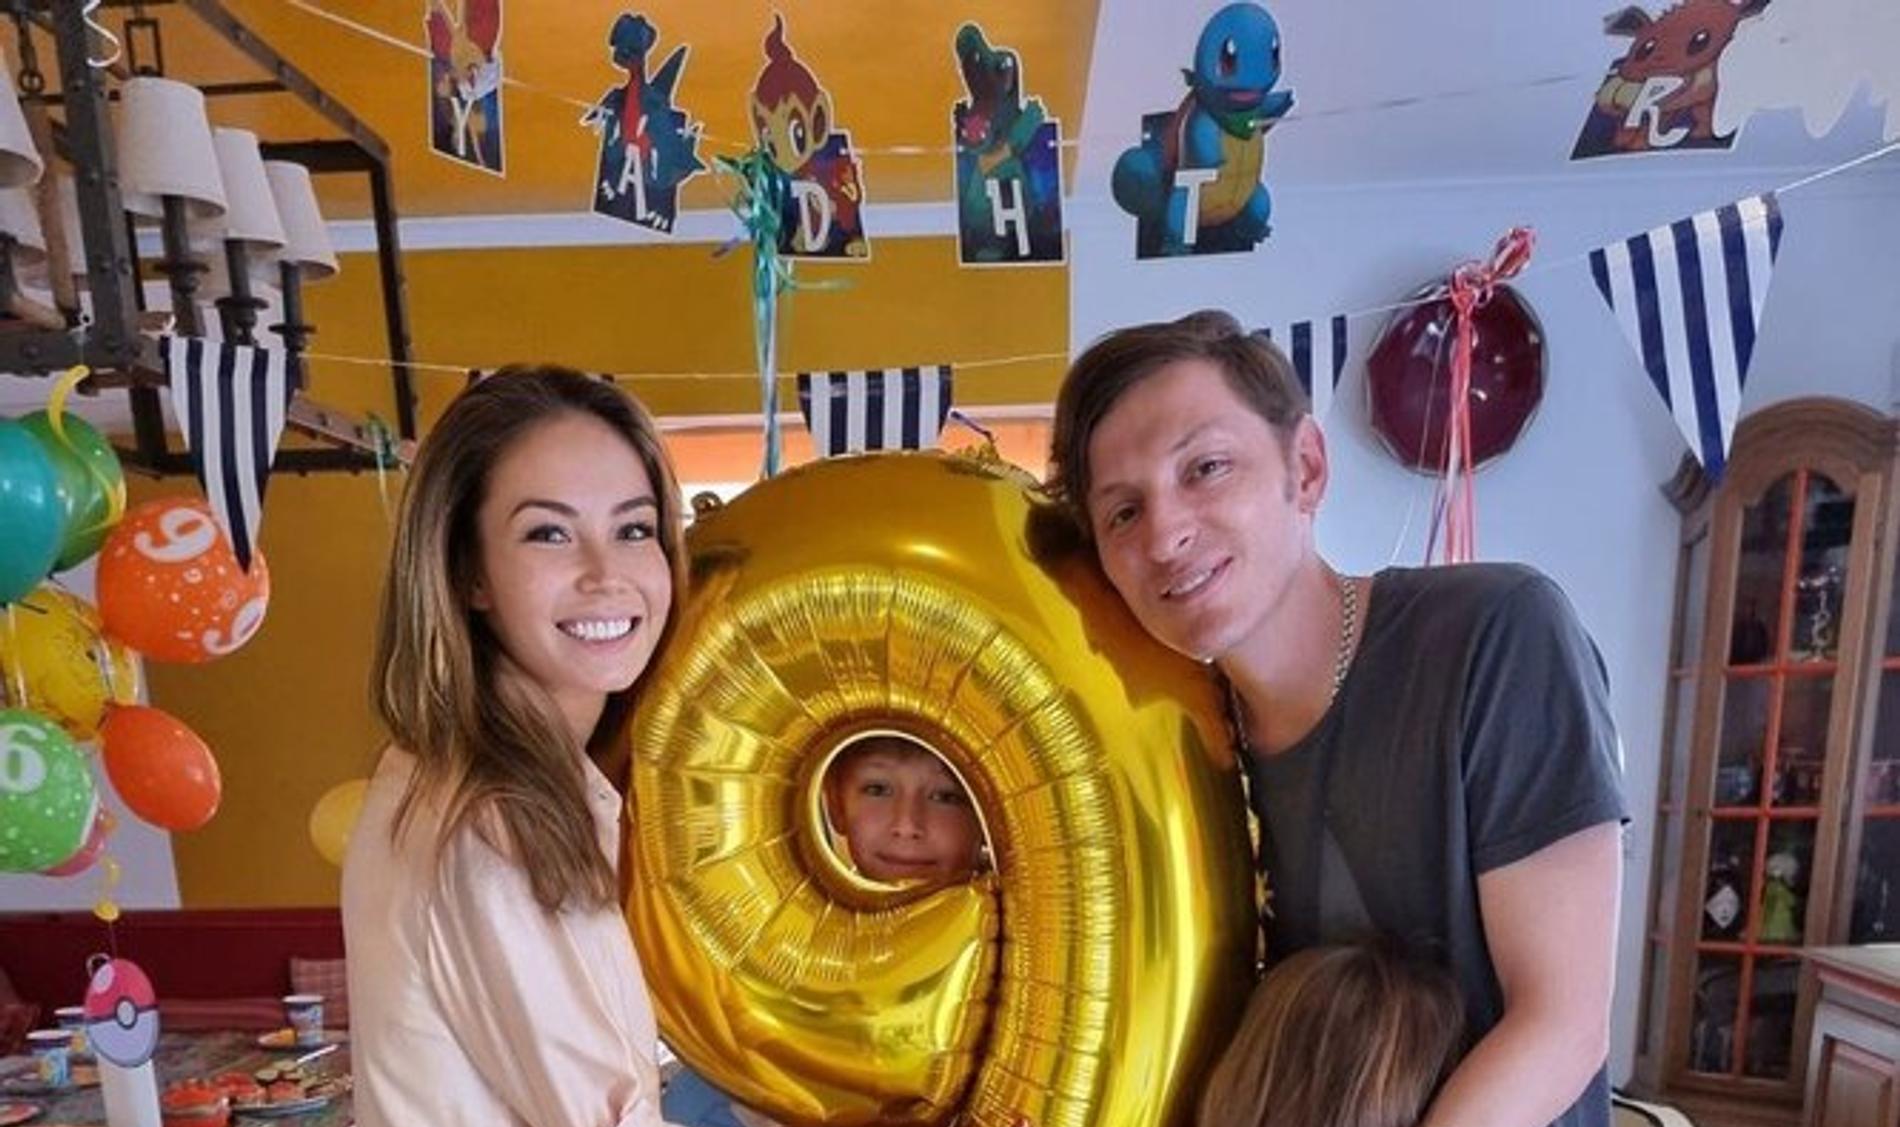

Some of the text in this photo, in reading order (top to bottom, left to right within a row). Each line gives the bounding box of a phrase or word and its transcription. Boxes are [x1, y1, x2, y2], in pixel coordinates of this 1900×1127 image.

[450, 76, 1690, 256] Y A D H T R
